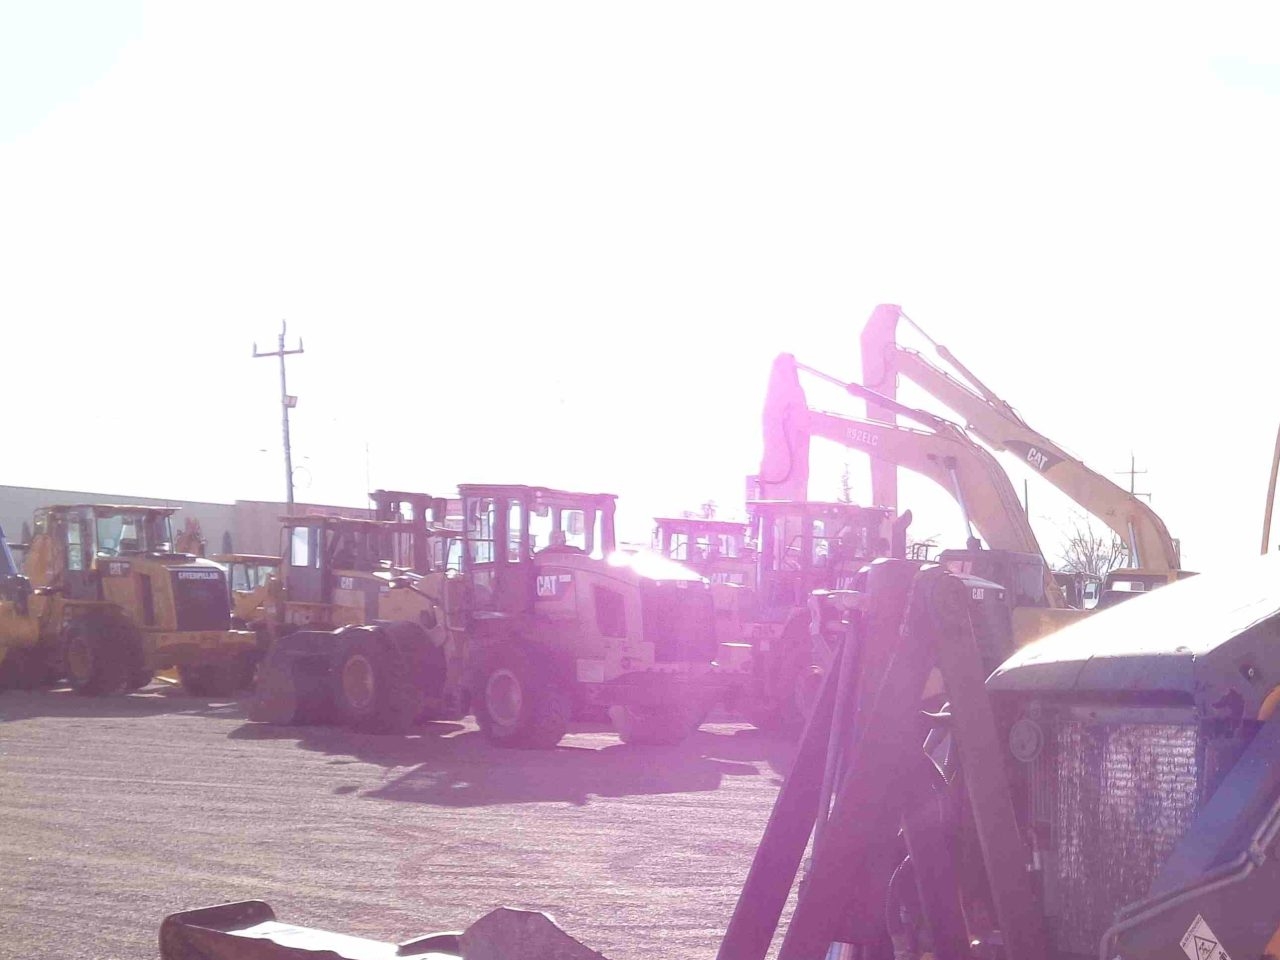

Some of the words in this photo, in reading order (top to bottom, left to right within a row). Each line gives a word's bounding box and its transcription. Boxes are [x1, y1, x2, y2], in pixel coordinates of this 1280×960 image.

[1026, 447, 1048, 470] CAT
[536, 575, 557, 597] CAT
[971, 588, 985, 600] CAT
